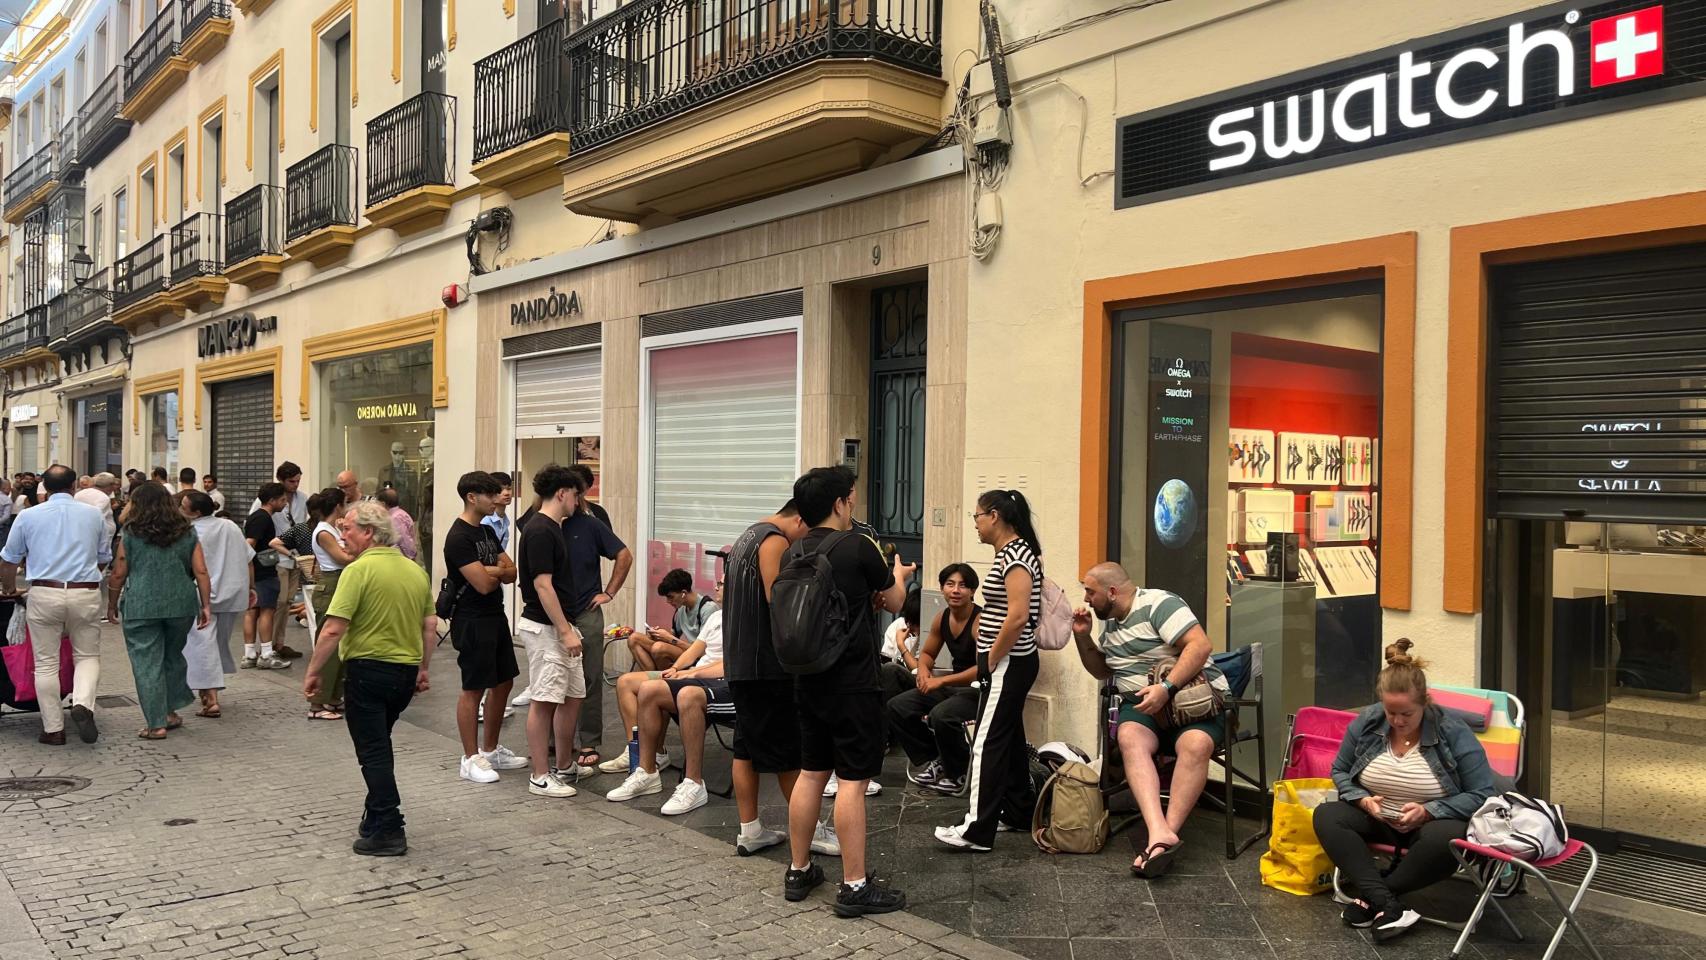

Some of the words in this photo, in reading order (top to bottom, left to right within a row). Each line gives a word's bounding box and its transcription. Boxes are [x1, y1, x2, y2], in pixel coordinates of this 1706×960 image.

[1208, 22, 1575, 171] swatch
[872, 245, 881, 266] 9
[198, 312, 257, 358] MANGO
[1167, 368, 1191, 378] OMEGA
[1165, 388, 1193, 398] swatch
[1162, 416, 1194, 426] MISSION
[1172, 425, 1183, 433] TO
[1154, 433, 1202, 442] EARTHPHASE
